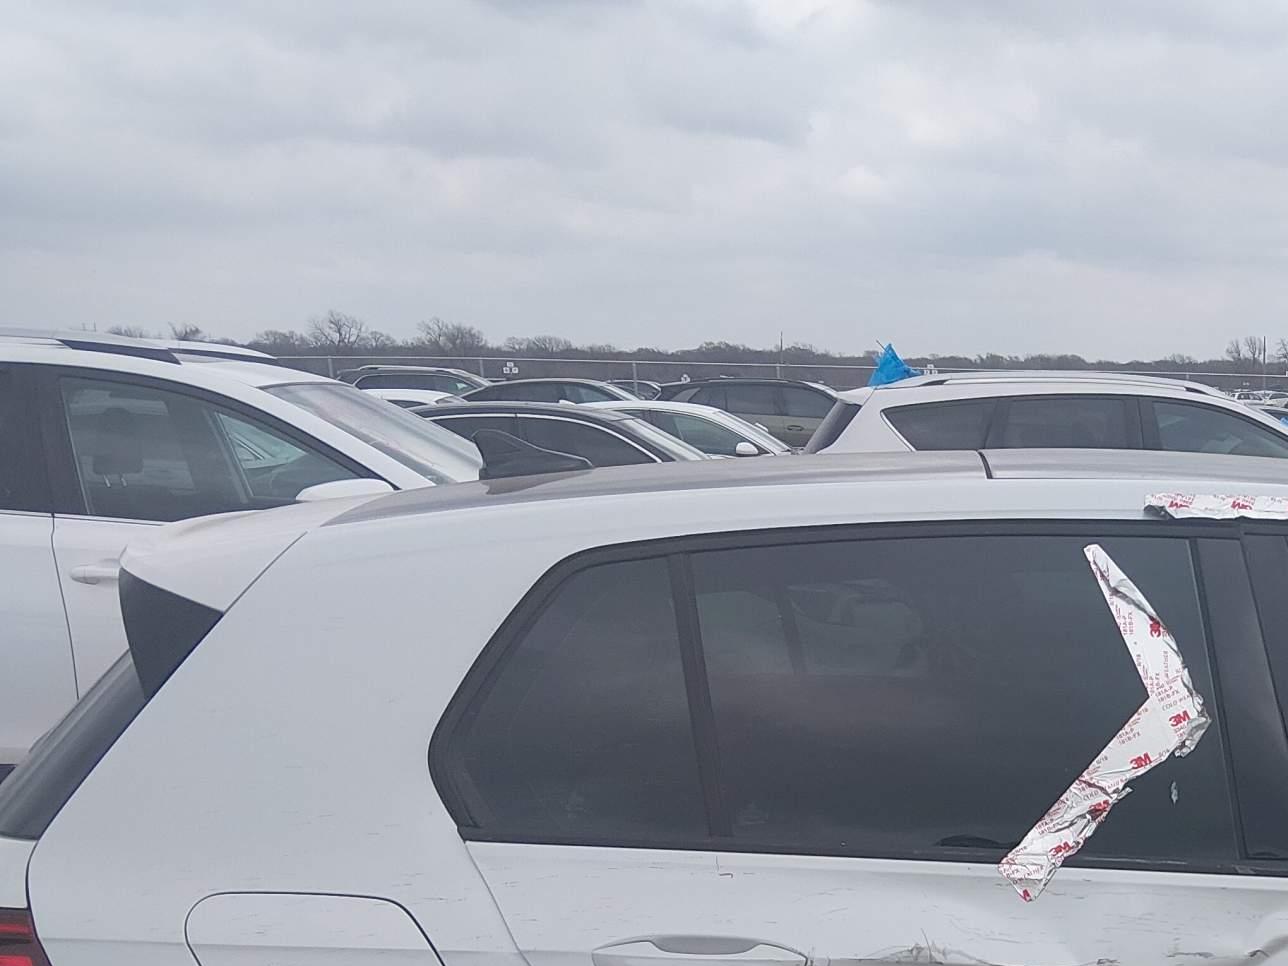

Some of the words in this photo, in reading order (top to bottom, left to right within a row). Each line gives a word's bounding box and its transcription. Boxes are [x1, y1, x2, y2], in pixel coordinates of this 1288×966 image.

[1169, 709, 1190, 728] 3M
[1130, 752, 1152, 770] 3M
[1048, 841, 1071, 857] 3M
